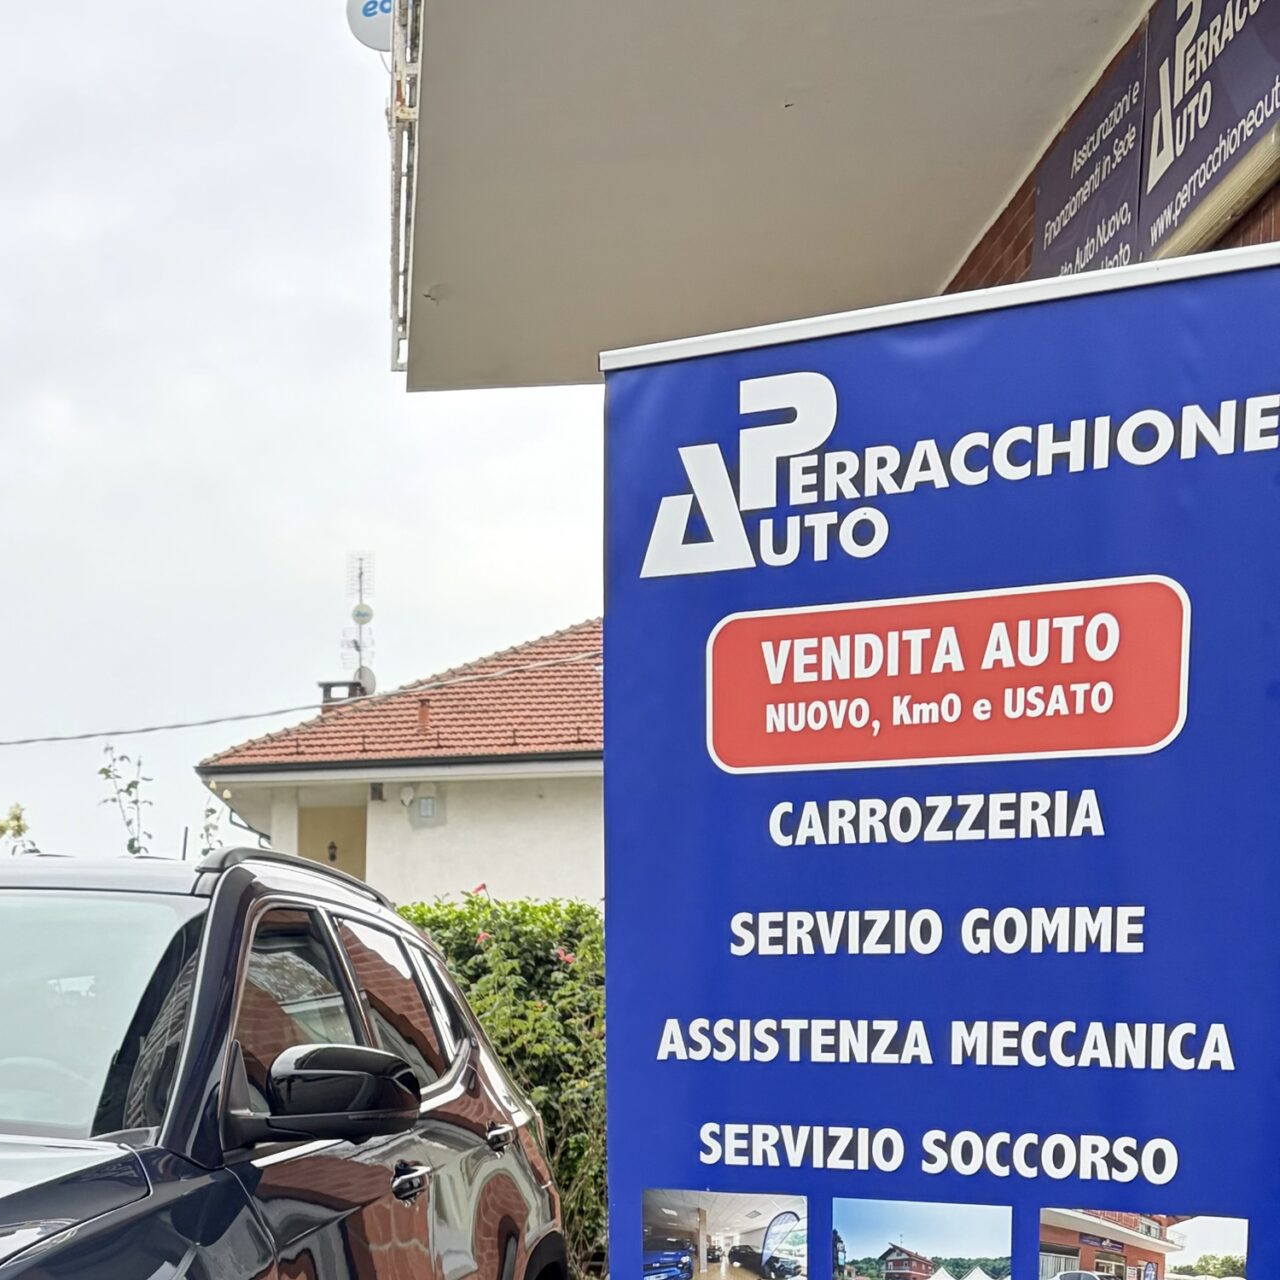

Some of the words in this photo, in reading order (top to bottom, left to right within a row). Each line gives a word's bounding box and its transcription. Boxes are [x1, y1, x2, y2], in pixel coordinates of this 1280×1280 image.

[1070, 84, 1132, 179] Assicurazioni
[1132, 81, 1140, 104] e
[1147, 57, 1212, 194] AUTO
[1043, 161, 1101, 251] Finanziamenti
[1101, 155, 1111, 182] in
[1111, 122, 1136, 170] Sede
[1074, 236, 1095, 274] Auto
[1095, 202, 1132, 253] Nuovo,
[739, 371, 1280, 512] PERRACCHIONE
[640, 443, 890, 579] AUTO
[761, 626, 965, 686] VENDITA
[981, 612, 1120, 670] AUTO
[766, 698, 881, 737] NUOVO,
[972, 698, 992, 721] e
[1004, 681, 1114, 719] USATO
[769, 789, 1105, 847] CARROZZERIA
[730, 908, 943, 956] SERVIZIO
[961, 906, 1145, 954] GOMME
[656, 1017, 933, 1065] ASSISTENZA
[951, 1020, 1235, 1071] MECCANICA
[699, 1122, 905, 1172] SERVIZIO
[921, 1129, 1179, 1185] SOCCORSO
